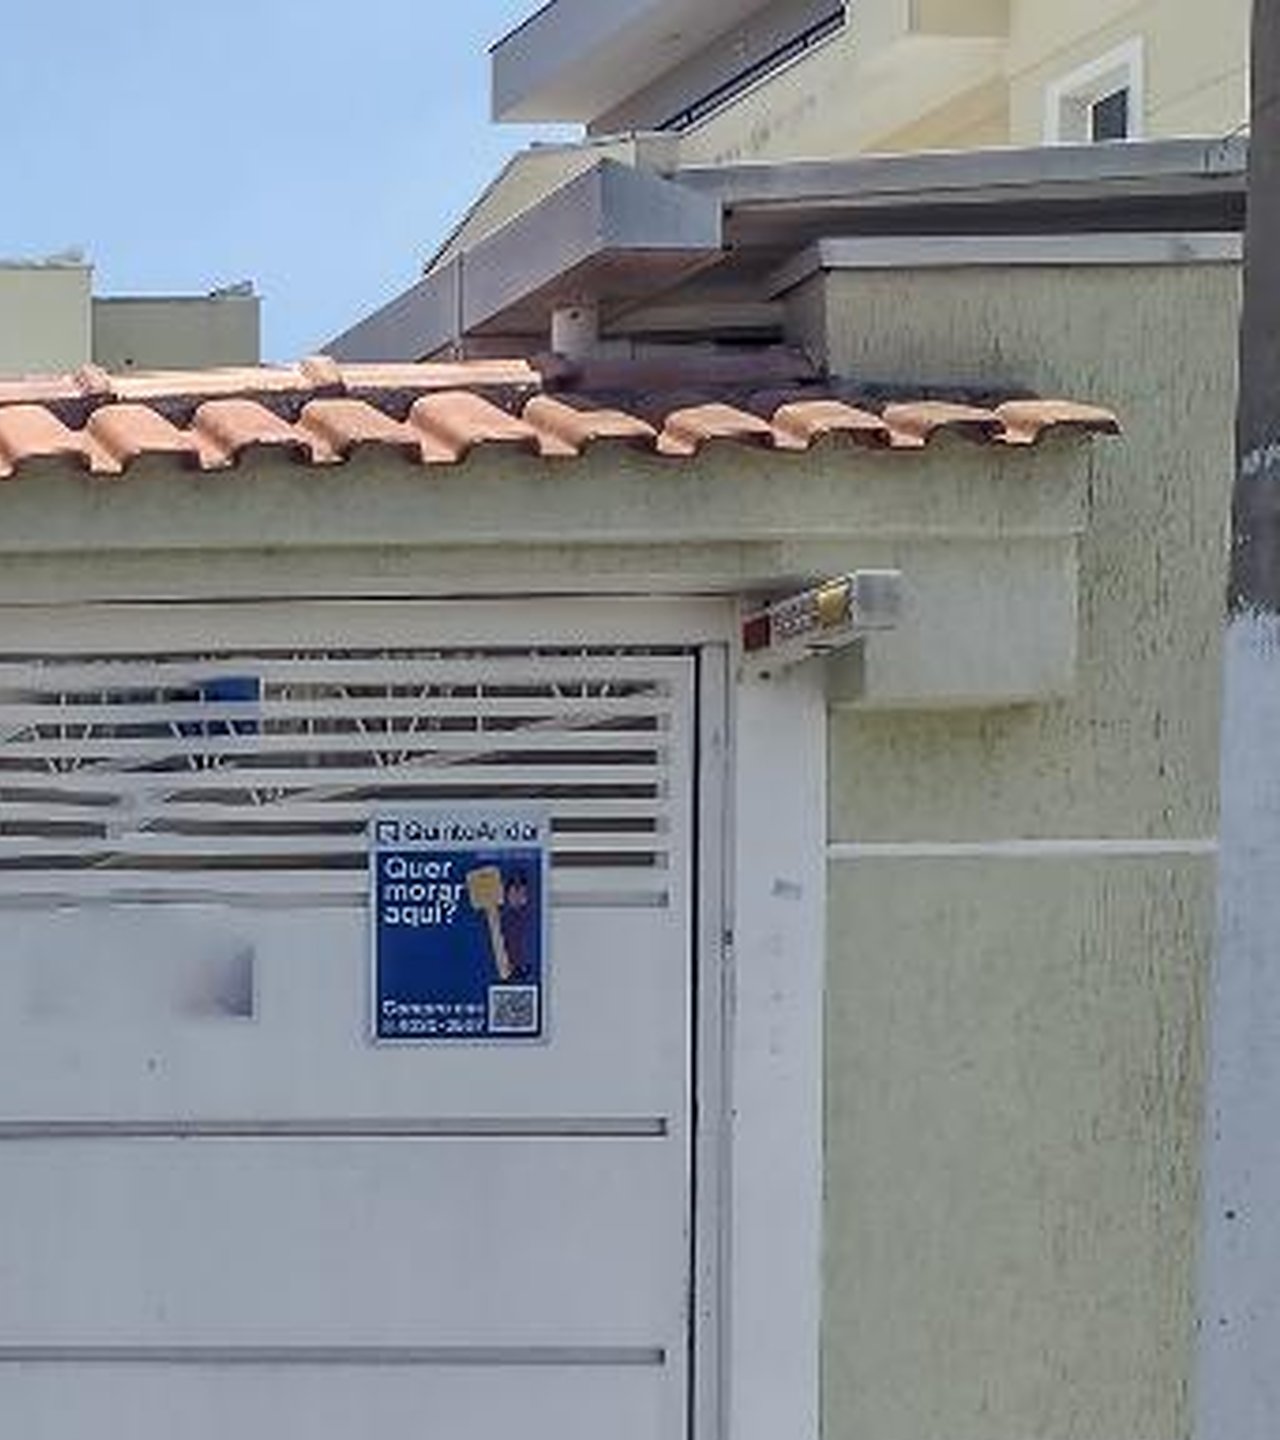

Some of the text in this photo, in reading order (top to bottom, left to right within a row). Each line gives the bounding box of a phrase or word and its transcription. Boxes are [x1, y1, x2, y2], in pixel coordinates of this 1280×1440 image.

[384, 856, 453, 879] Quer
[384, 883, 466, 901] morar
[383, 899, 458, 928] aqui?
